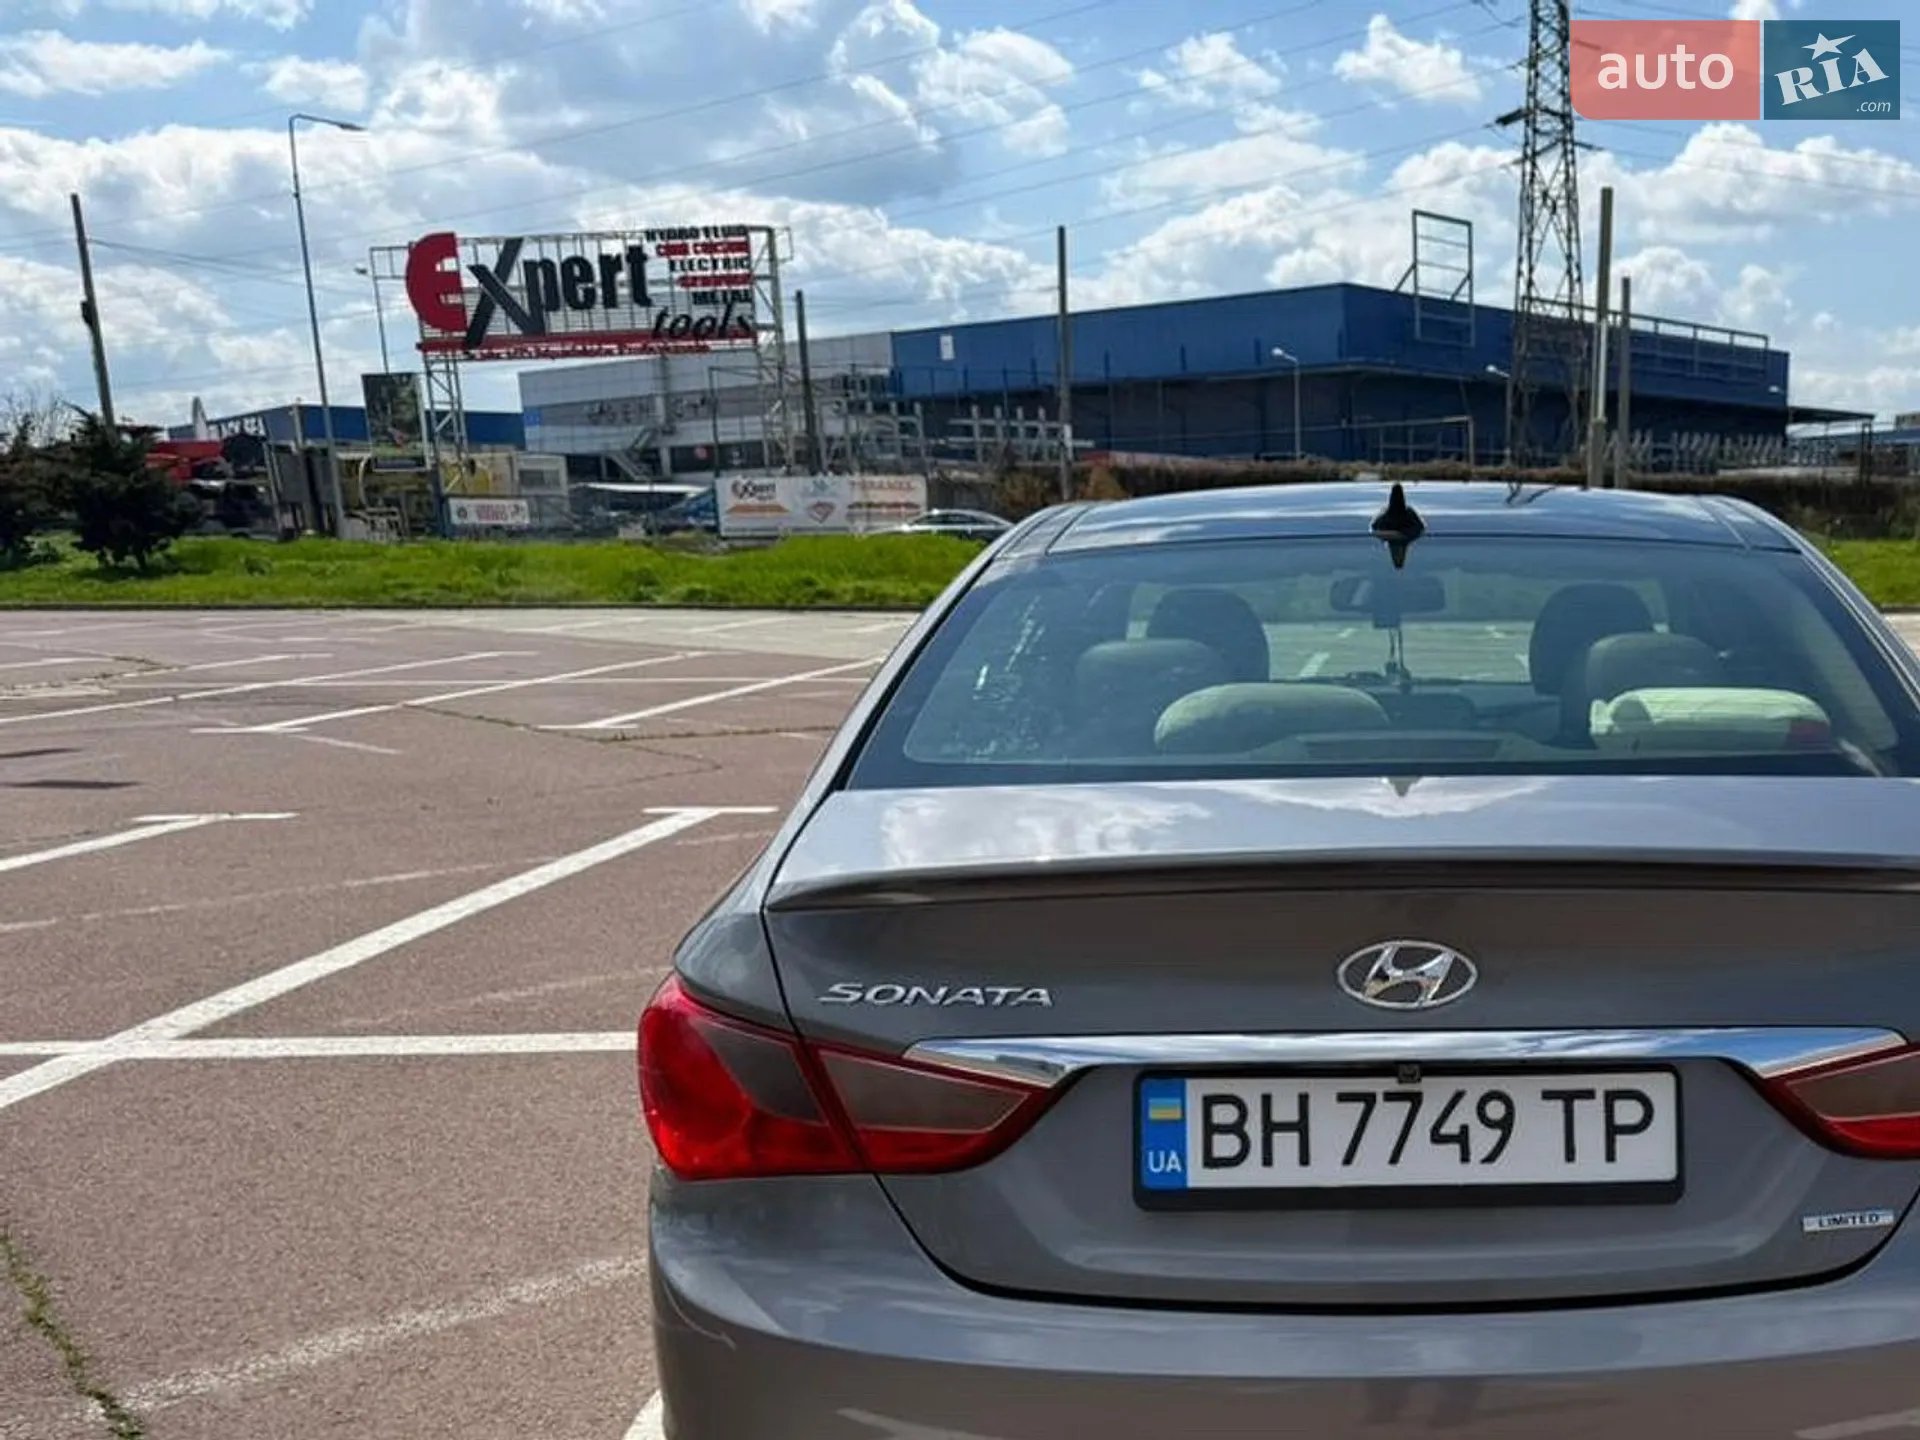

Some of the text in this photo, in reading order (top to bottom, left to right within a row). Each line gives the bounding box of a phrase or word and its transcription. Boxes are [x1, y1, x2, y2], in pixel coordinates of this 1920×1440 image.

[651, 303, 755, 340] tools
[818, 983, 1053, 1006] SONATA
[1201, 1089, 1655, 1169] BH 7749 TP
[1148, 1150, 1182, 1173] UA
